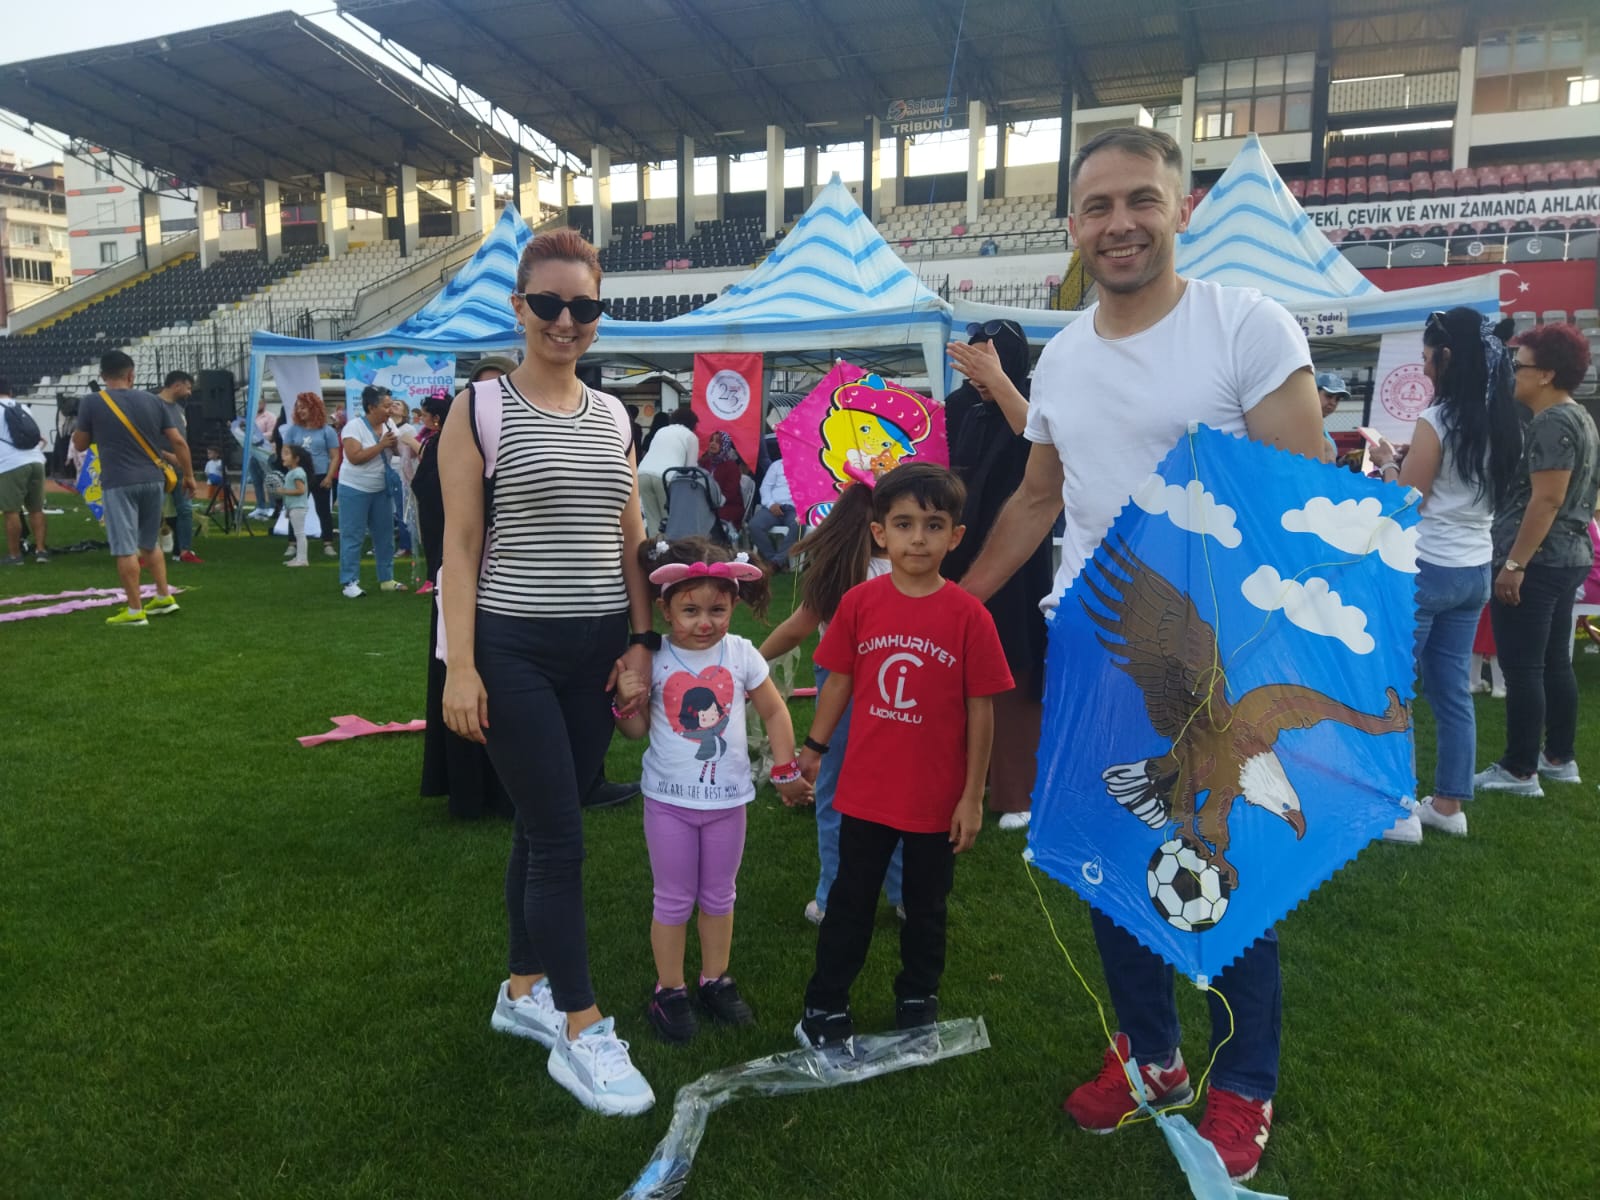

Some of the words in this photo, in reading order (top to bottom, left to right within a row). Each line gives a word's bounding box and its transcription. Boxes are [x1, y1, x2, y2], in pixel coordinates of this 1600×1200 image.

[891, 117, 953, 135] TRİBÜNÜ
[1348, 204, 1391, 228] ÇEVİK
[1397, 205, 1415, 222] VE
[1420, 202, 1455, 220] AYNI
[1460, 198, 1536, 219] ZAMANDA
[1541, 193, 1600, 213] AHLAK
[1316, 324, 1335, 336] 35
[390, 374, 453, 388] Uçurtma
[857, 633, 957, 669] CUMHURİYET
[670, 783, 684, 797] ARE
[687, 784, 701, 800] THE
[704, 785, 722, 800] BEST
